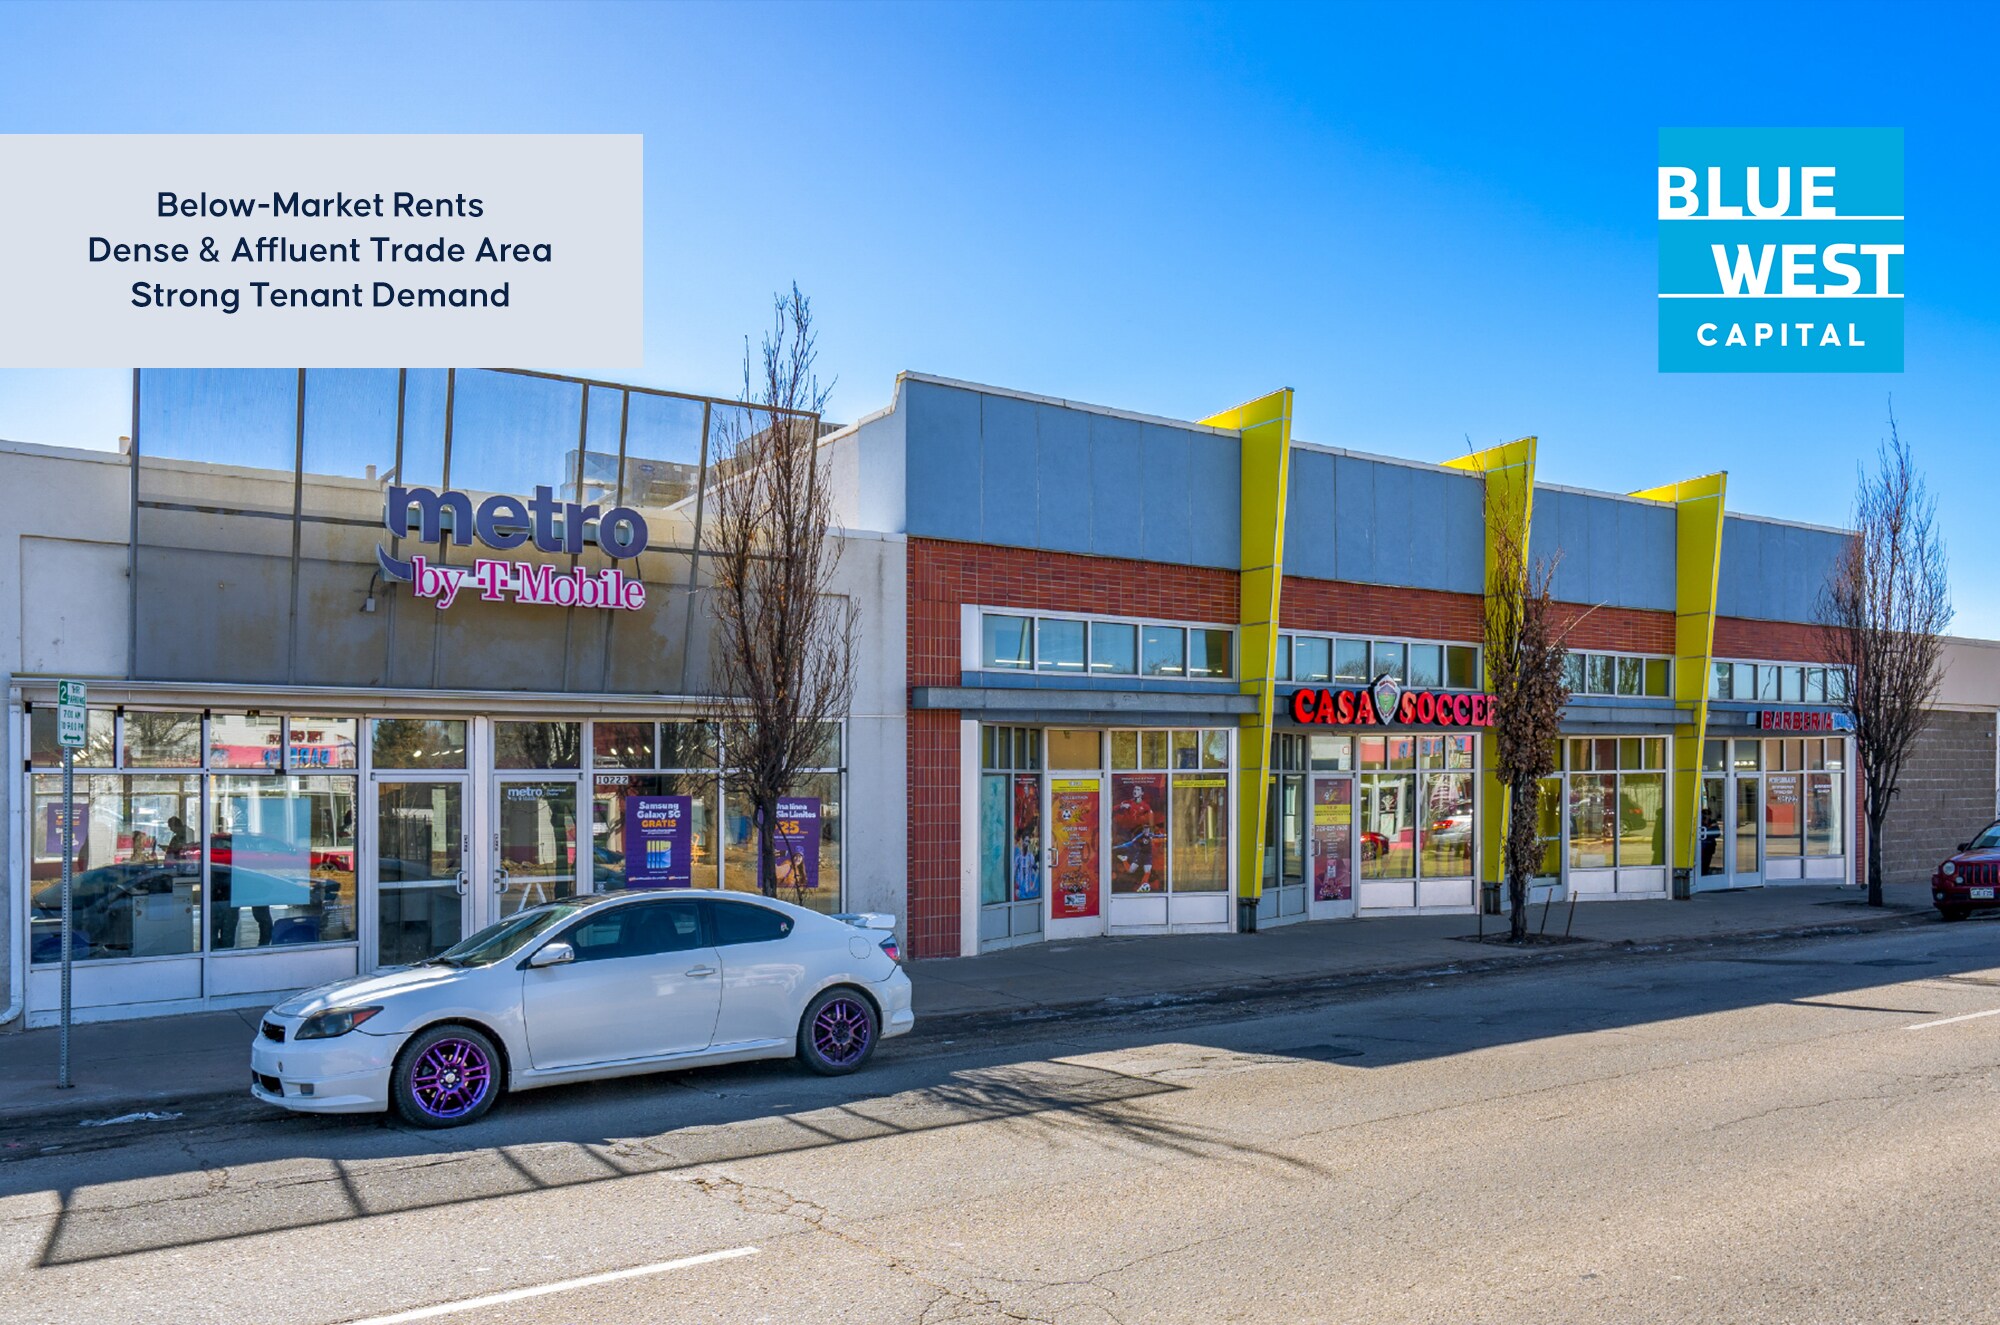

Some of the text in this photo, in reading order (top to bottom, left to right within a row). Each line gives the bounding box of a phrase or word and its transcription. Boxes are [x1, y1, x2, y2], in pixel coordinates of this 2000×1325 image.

[384, 484, 649, 560] metro
[411, 555, 467, 609] by
[60, 685, 67, 702] 2
[1294, 687, 1377, 724] CASA
[1761, 710, 1833, 730] BARBERIA
[597, 776, 629, 785] 10222
[507, 787, 543, 797] metro
[638, 801, 680, 811] Samsung
[636, 810, 681, 820] Galaxy 5G
[641, 819, 677, 828] GRATIS
[774, 820, 800, 834] 25
